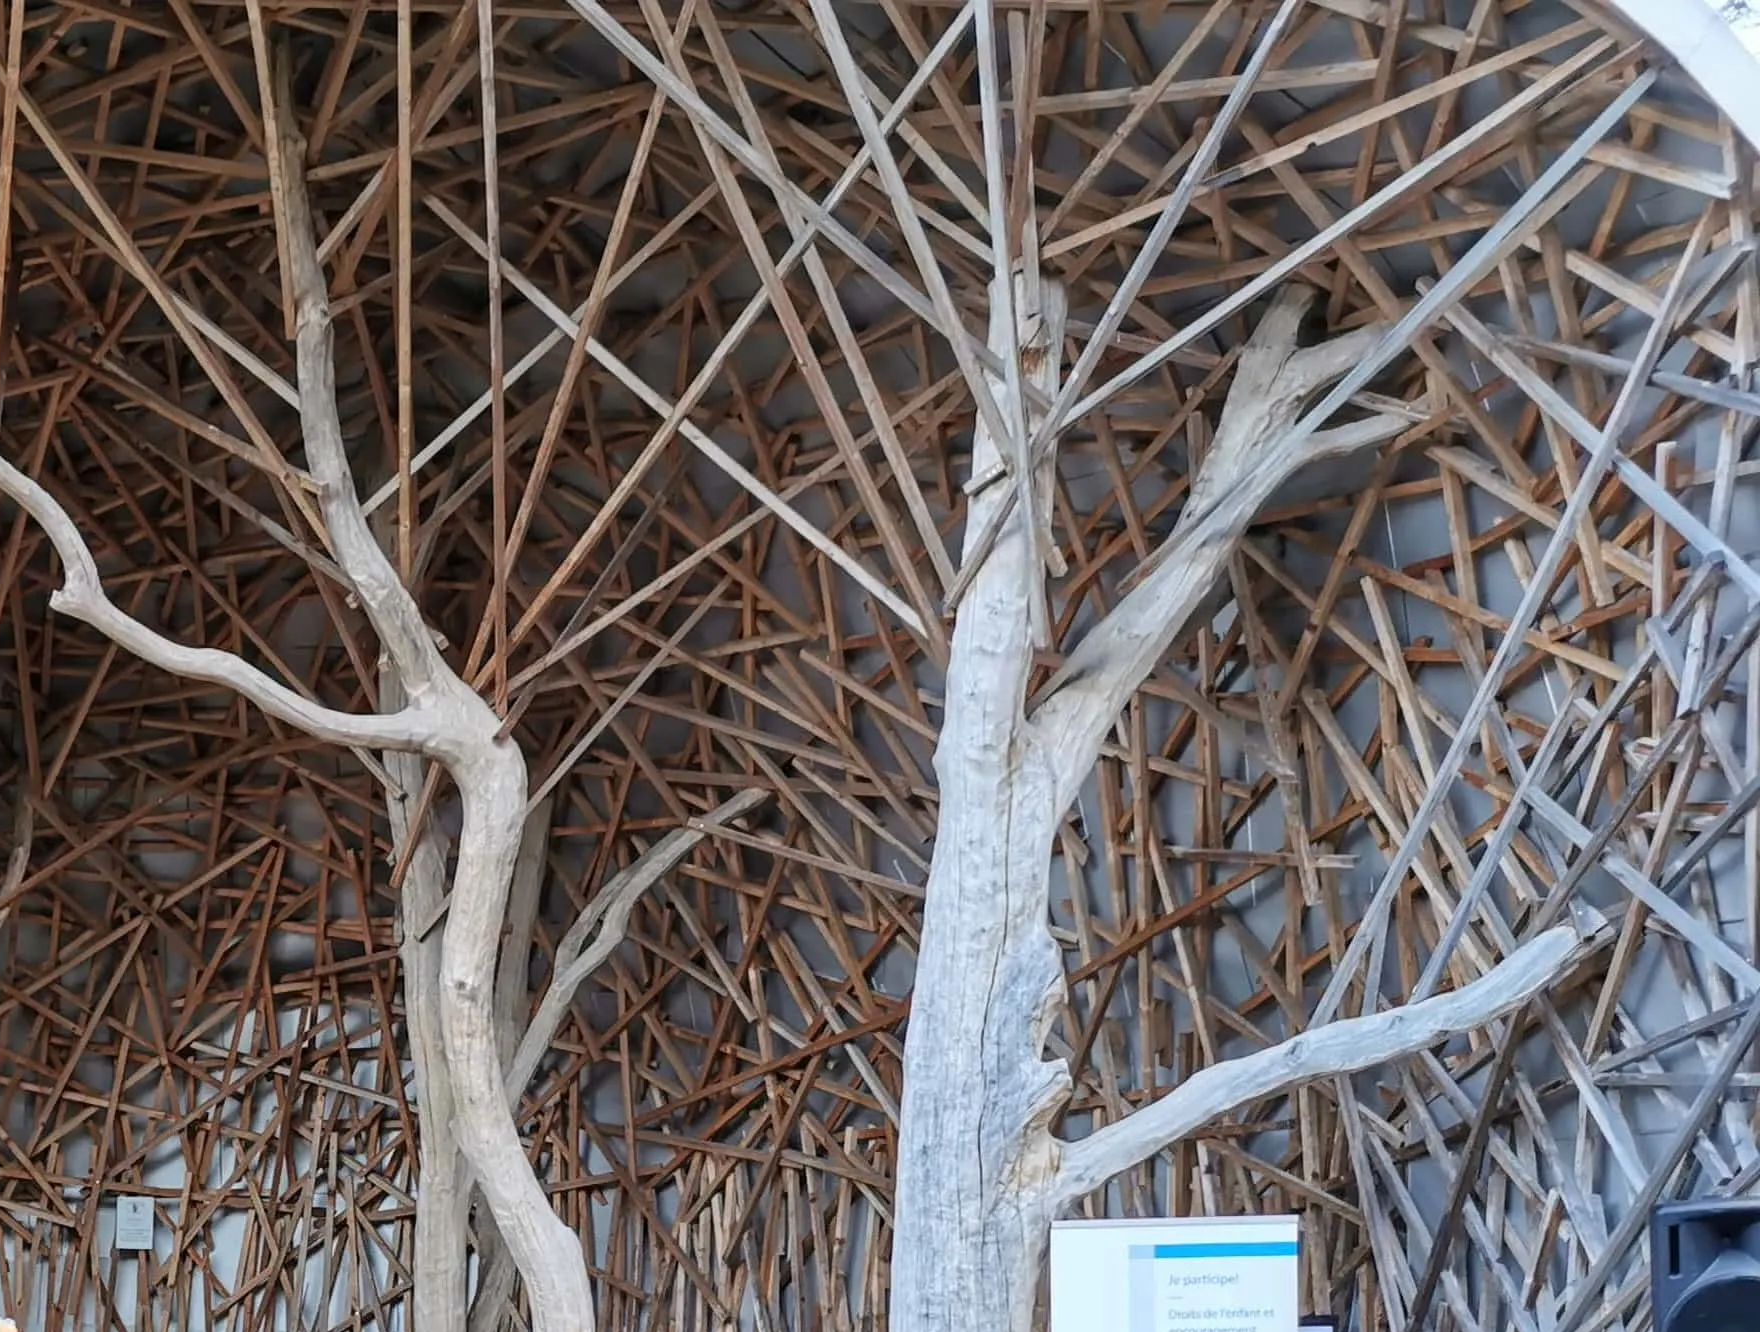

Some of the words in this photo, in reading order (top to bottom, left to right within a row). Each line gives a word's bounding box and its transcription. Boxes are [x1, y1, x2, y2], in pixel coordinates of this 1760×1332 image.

[1168, 1273, 1180, 1288] Je
[1183, 1273, 1239, 1288] participe!
[1168, 1308, 1202, 1319] Droits
[1203, 1308, 1218, 1319] de
[1262, 1309, 1275, 1319] et
